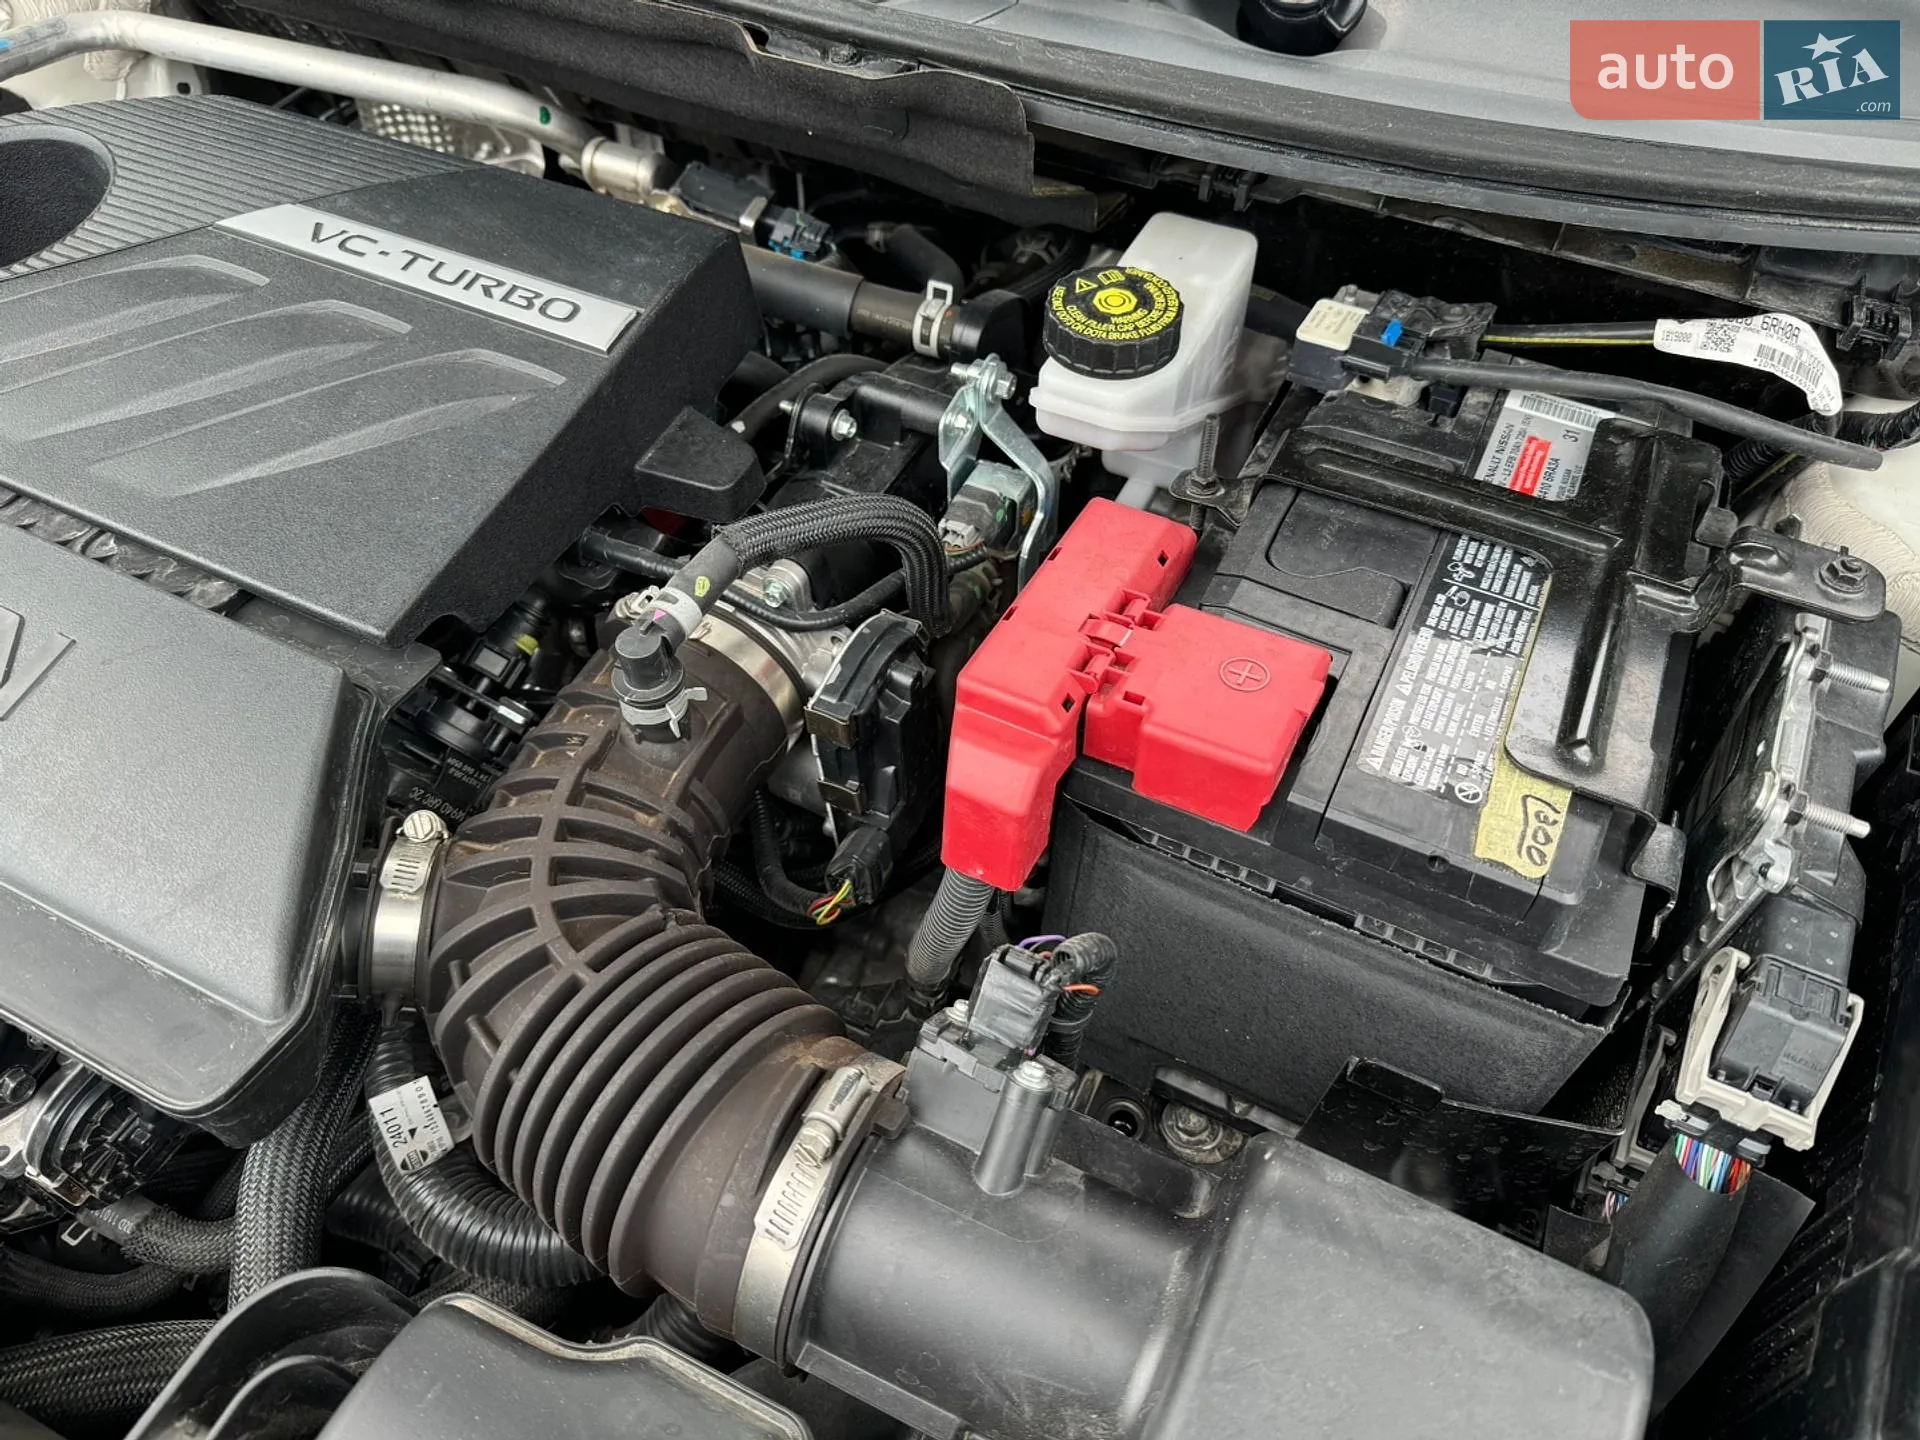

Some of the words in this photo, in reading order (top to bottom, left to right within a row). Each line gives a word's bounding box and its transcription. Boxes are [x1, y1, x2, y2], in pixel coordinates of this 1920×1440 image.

[310, 222, 581, 324] VC-TURBO
[1066, 305, 1088, 322] CLEAN
[1085, 319, 1115, 331] FILLER
[1117, 323, 1134, 331] CAP
[1135, 310, 1163, 328] BEFORE
[1111, 308, 1148, 324] WARNING
[1084, 327, 1107, 338] DOT4
[1108, 330, 1140, 340] BRAKE
[1139, 323, 1162, 336] FLUID
[1563, 429, 1582, 443] 31
[1484, 455, 1502, 482] ENAULT
[1497, 423, 1515, 454] NISSAN
[379, 1107, 408, 1148] 24011
